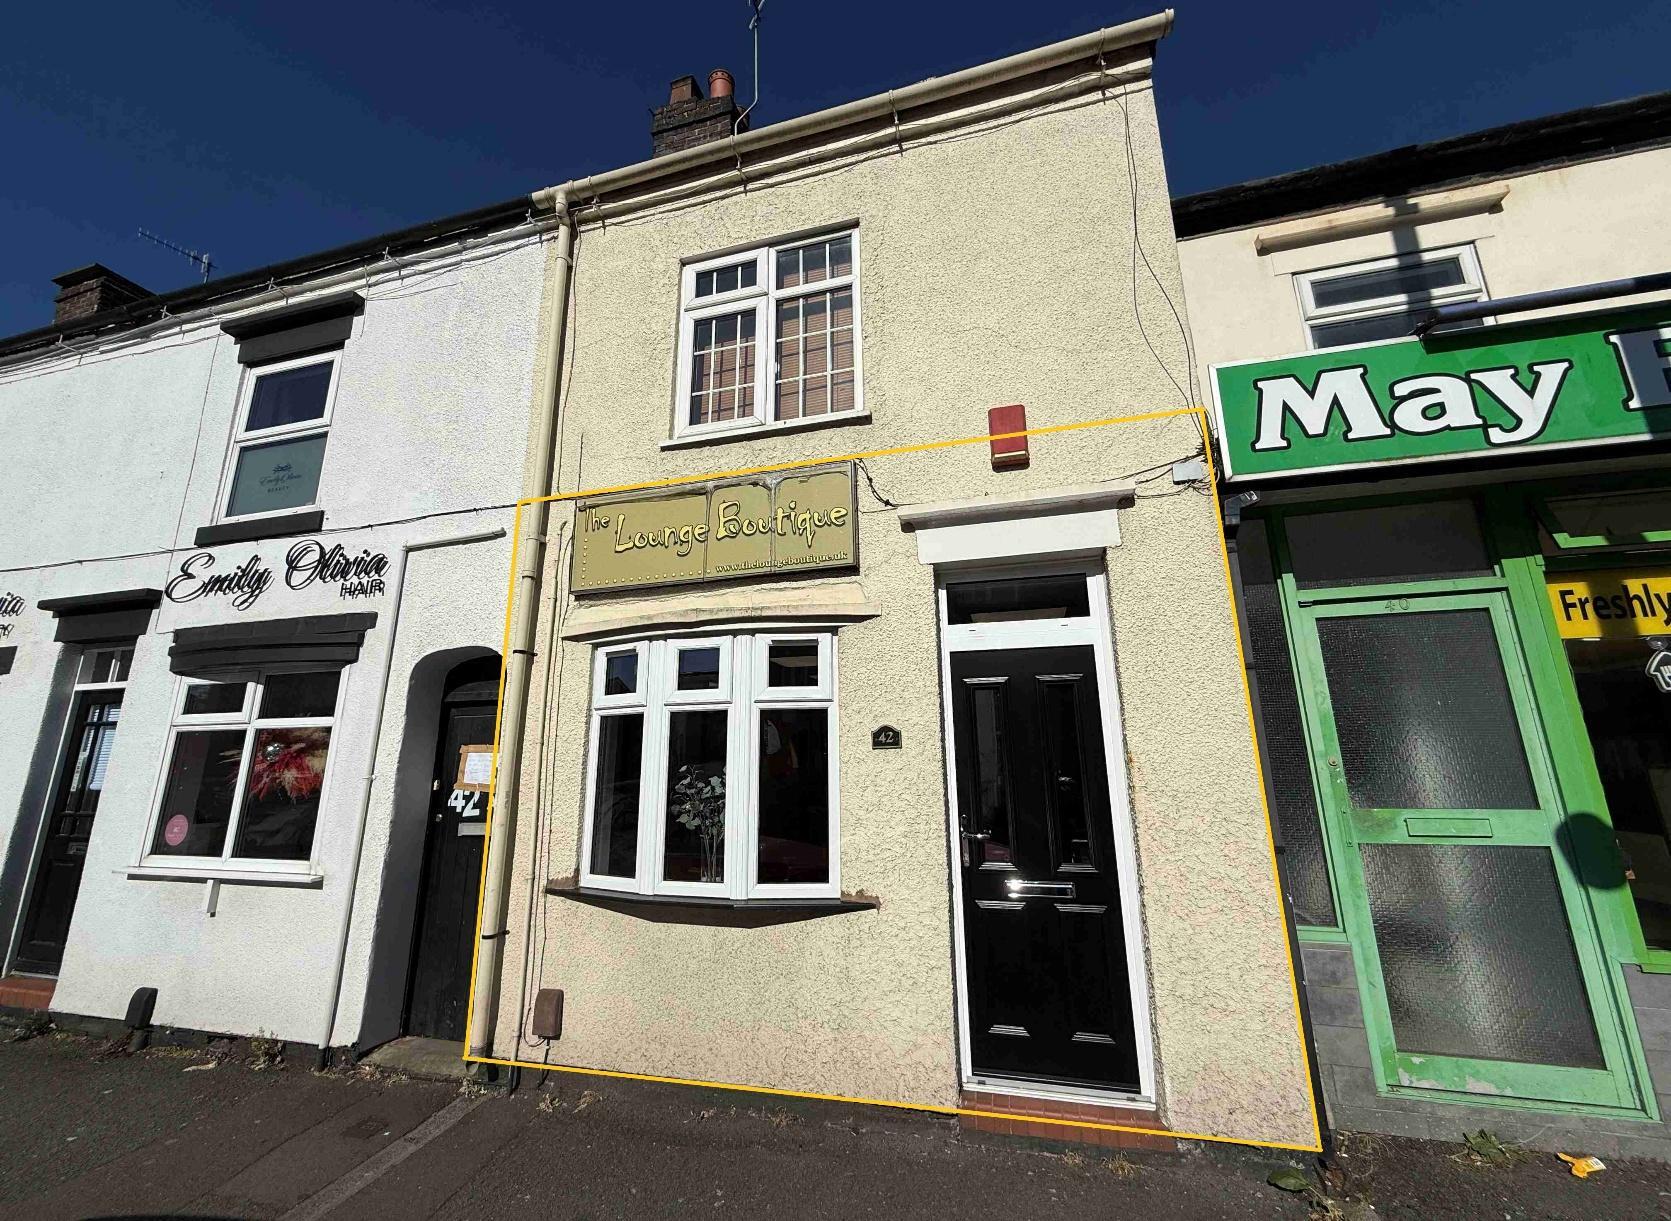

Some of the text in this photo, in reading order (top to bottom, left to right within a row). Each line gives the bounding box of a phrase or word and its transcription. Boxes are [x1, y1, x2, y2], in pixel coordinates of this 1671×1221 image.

[1251, 360, 1574, 450] May
[582, 500, 849, 557] The Lounge Boutique
[164, 539, 391, 611] Emily Olivia
[340, 579, 386, 600] HAIR
[1558, 582, 1671, 627] Freshly
[878, 731, 894, 743] 42
